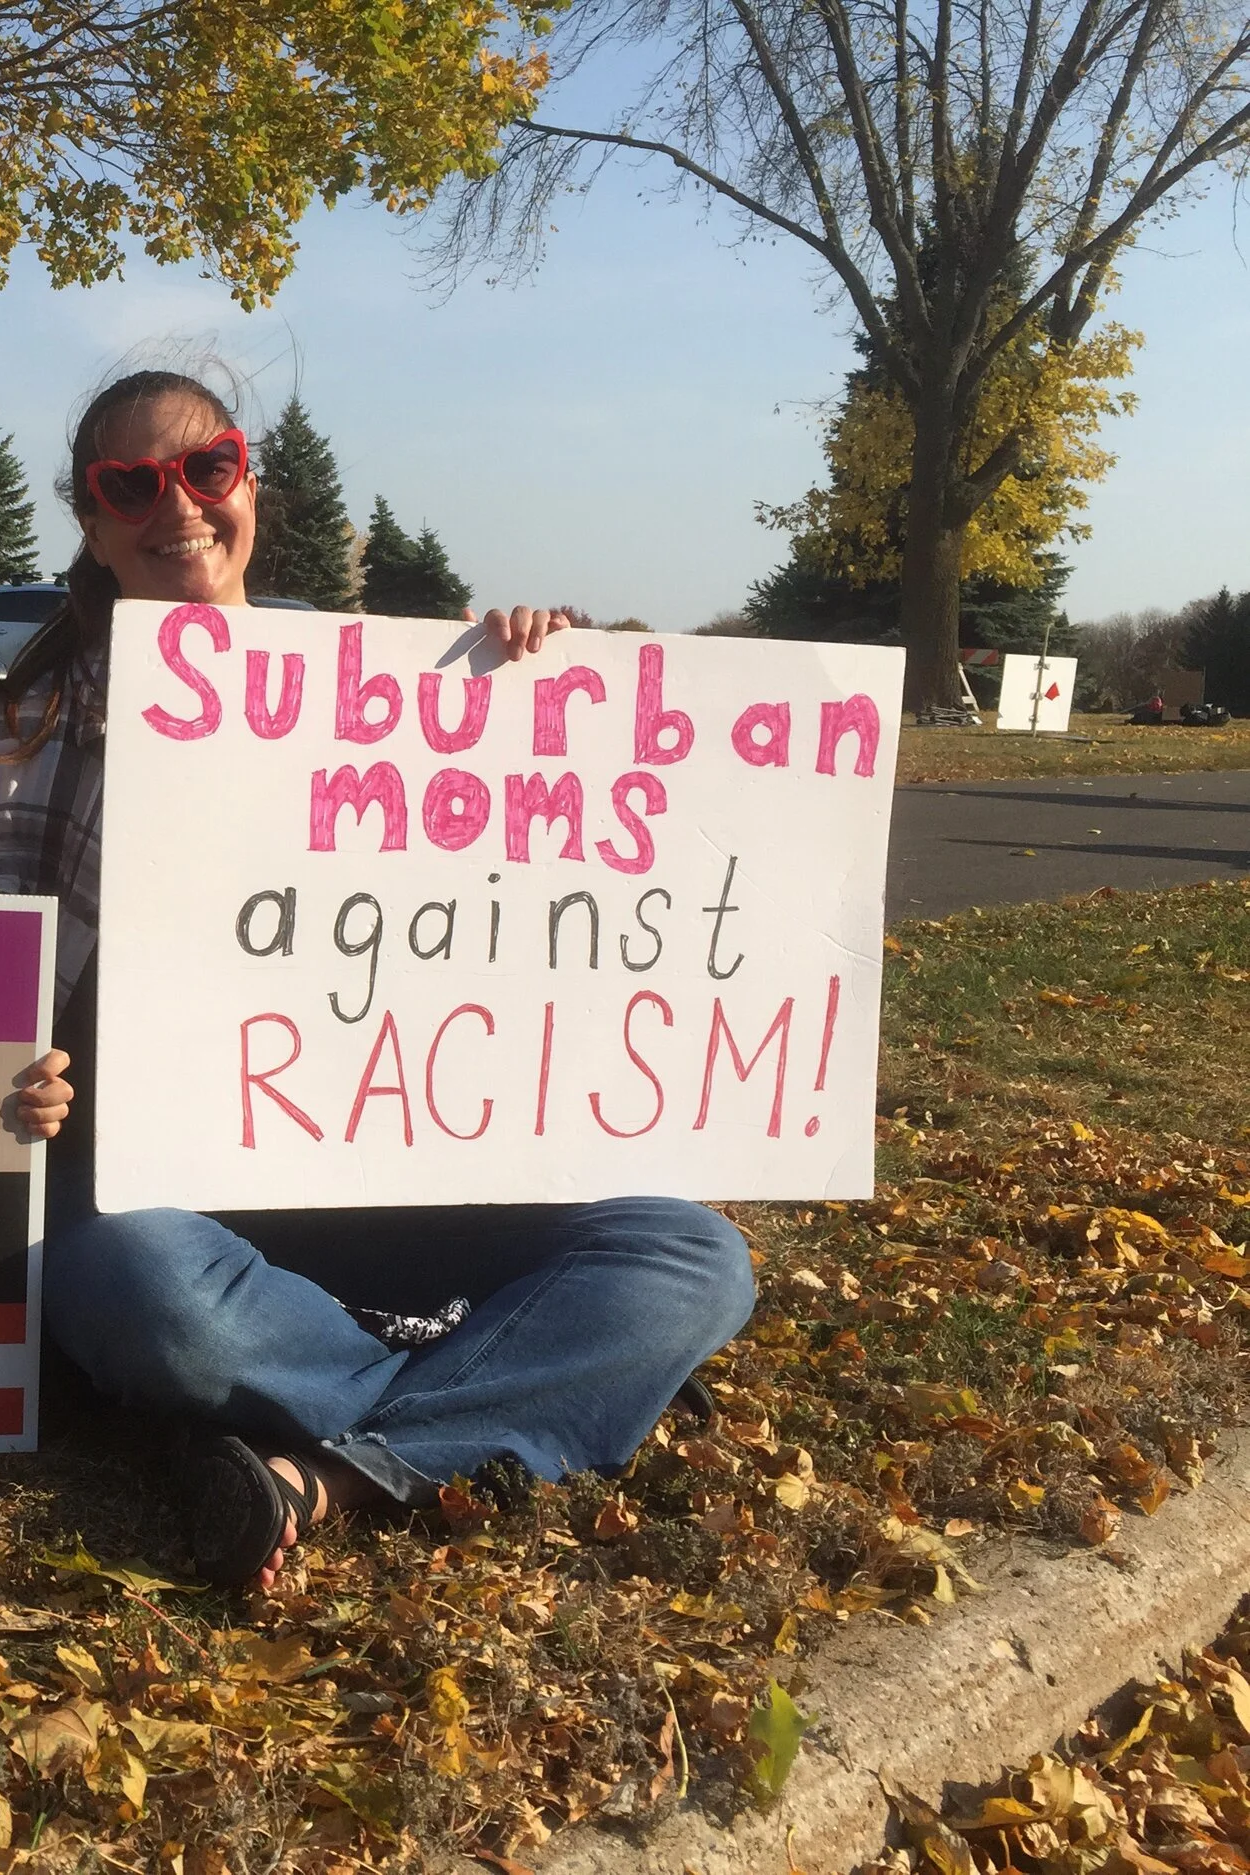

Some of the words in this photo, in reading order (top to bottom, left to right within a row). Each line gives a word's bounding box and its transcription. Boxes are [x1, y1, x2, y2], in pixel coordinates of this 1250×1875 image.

[141, 602, 880, 778] Suburban
[307, 760, 668, 875] moms
[235, 855, 745, 1024] against
[240, 975, 840, 1149] RACISM!
